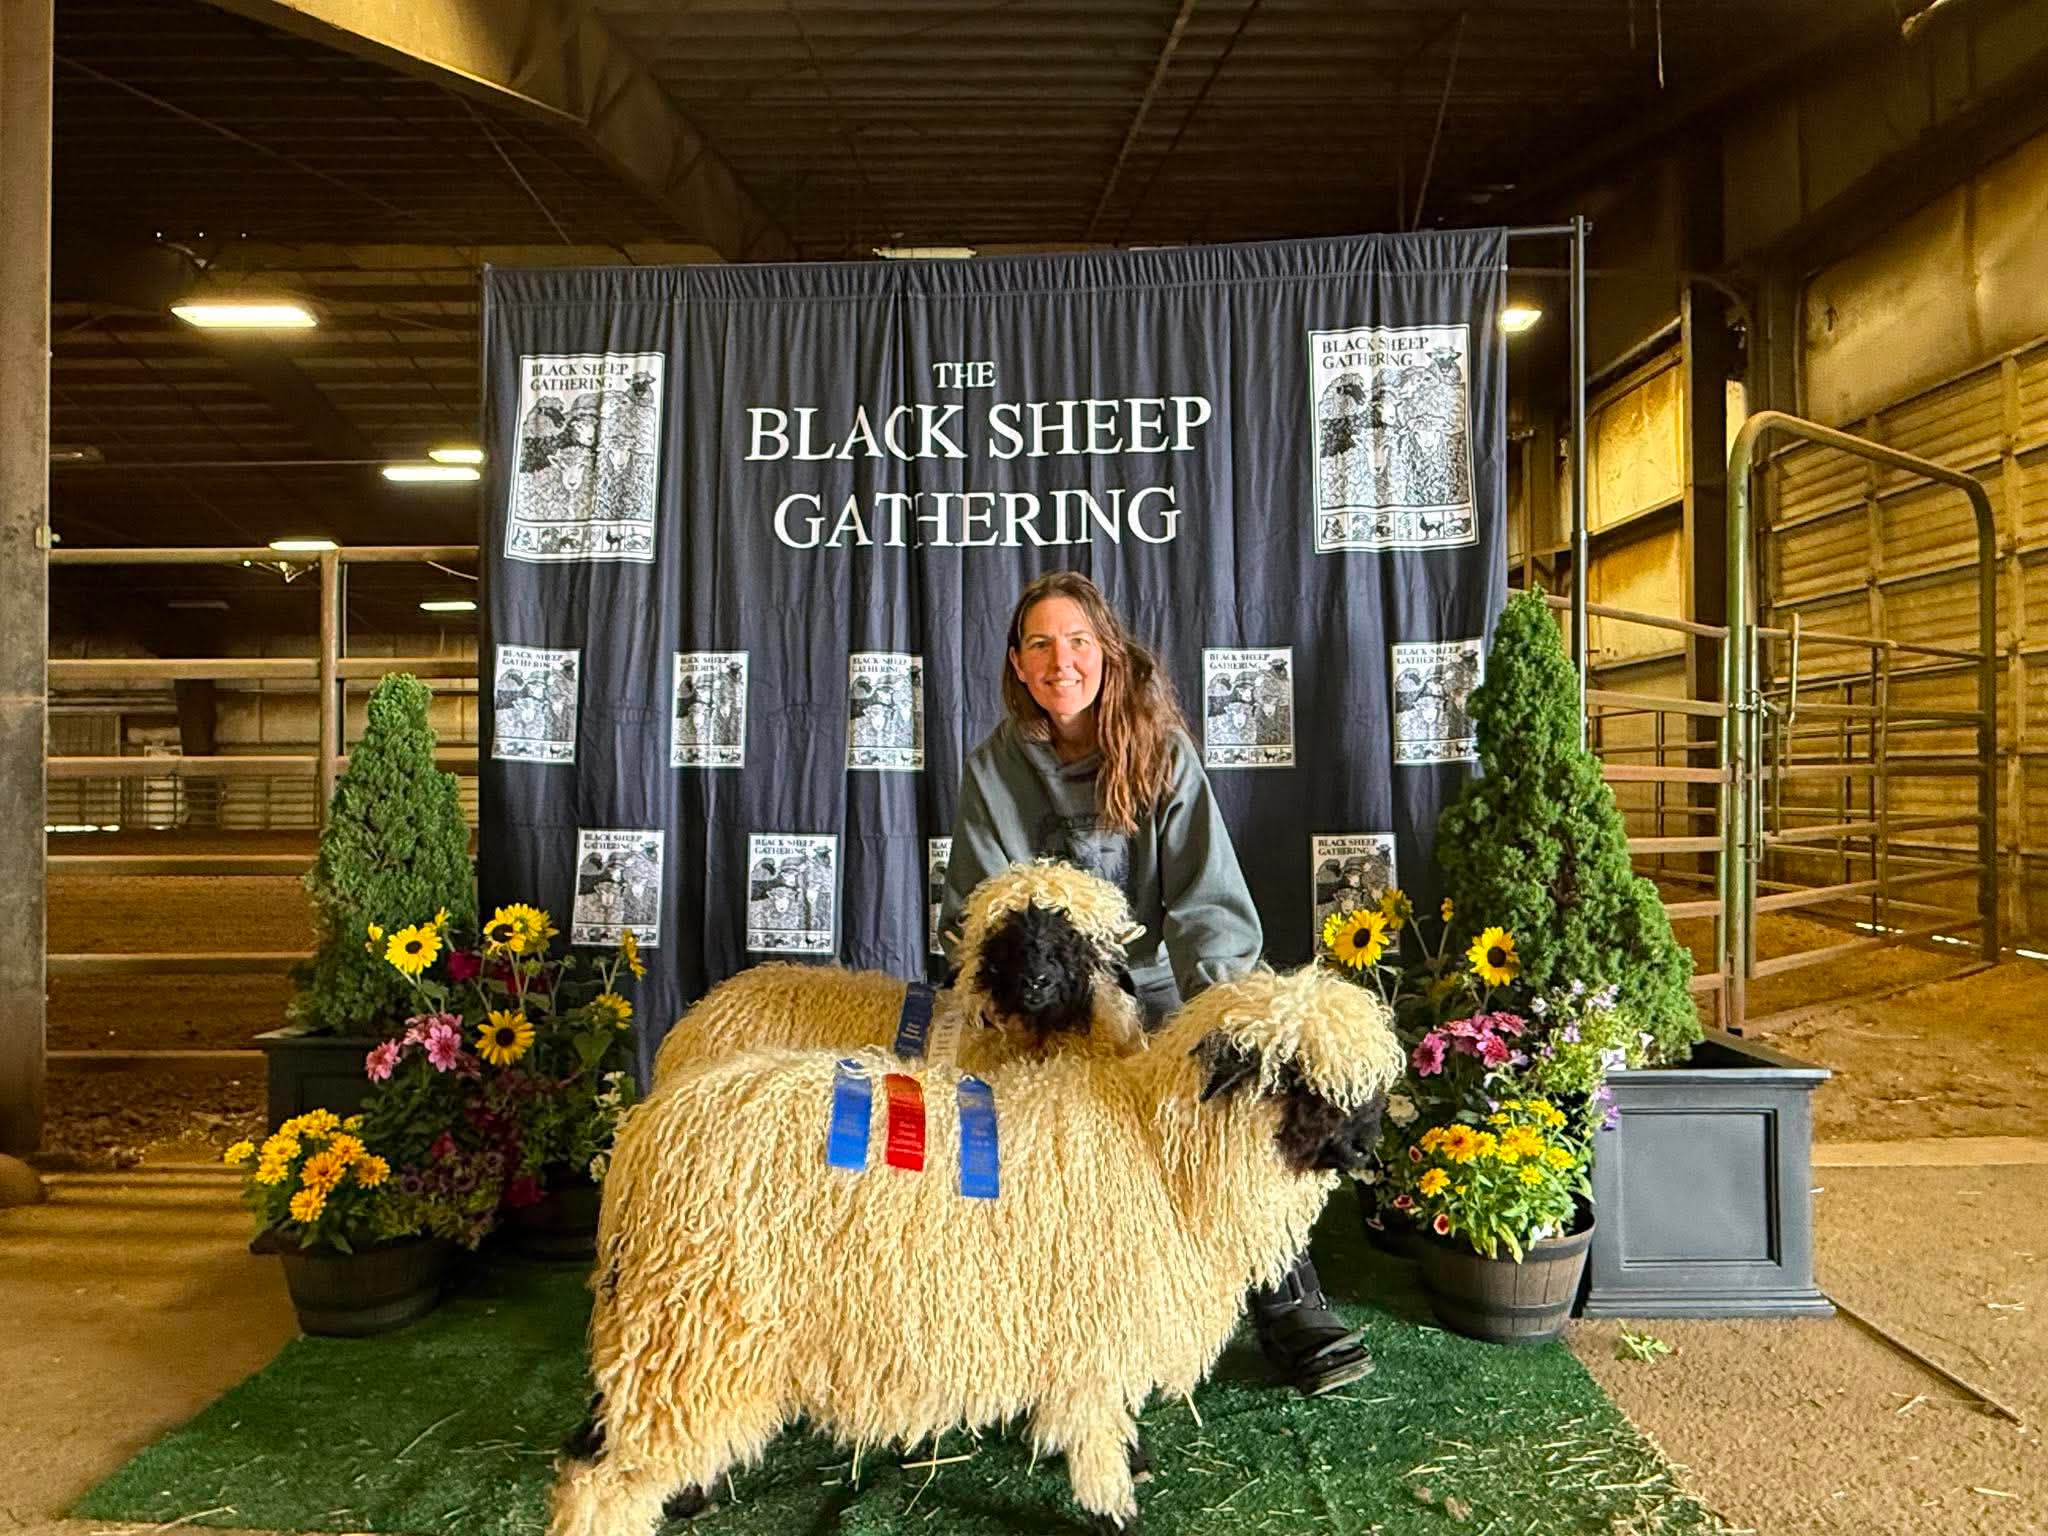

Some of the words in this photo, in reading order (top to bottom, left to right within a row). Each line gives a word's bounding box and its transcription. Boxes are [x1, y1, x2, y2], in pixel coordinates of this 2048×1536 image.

[1322, 337, 1375, 354] BLACK
[1378, 337, 1429, 351] SHEEP
[530, 363, 577, 377] BLACK
[1322, 352, 1413, 370] GATHERING
[530, 376, 613, 391] GATHERING
[932, 361, 997, 389] THE
[744, 404, 969, 461] BLACK
[988, 396, 1212, 460] SHEEP
[773, 485, 1183, 550] GATHERING
